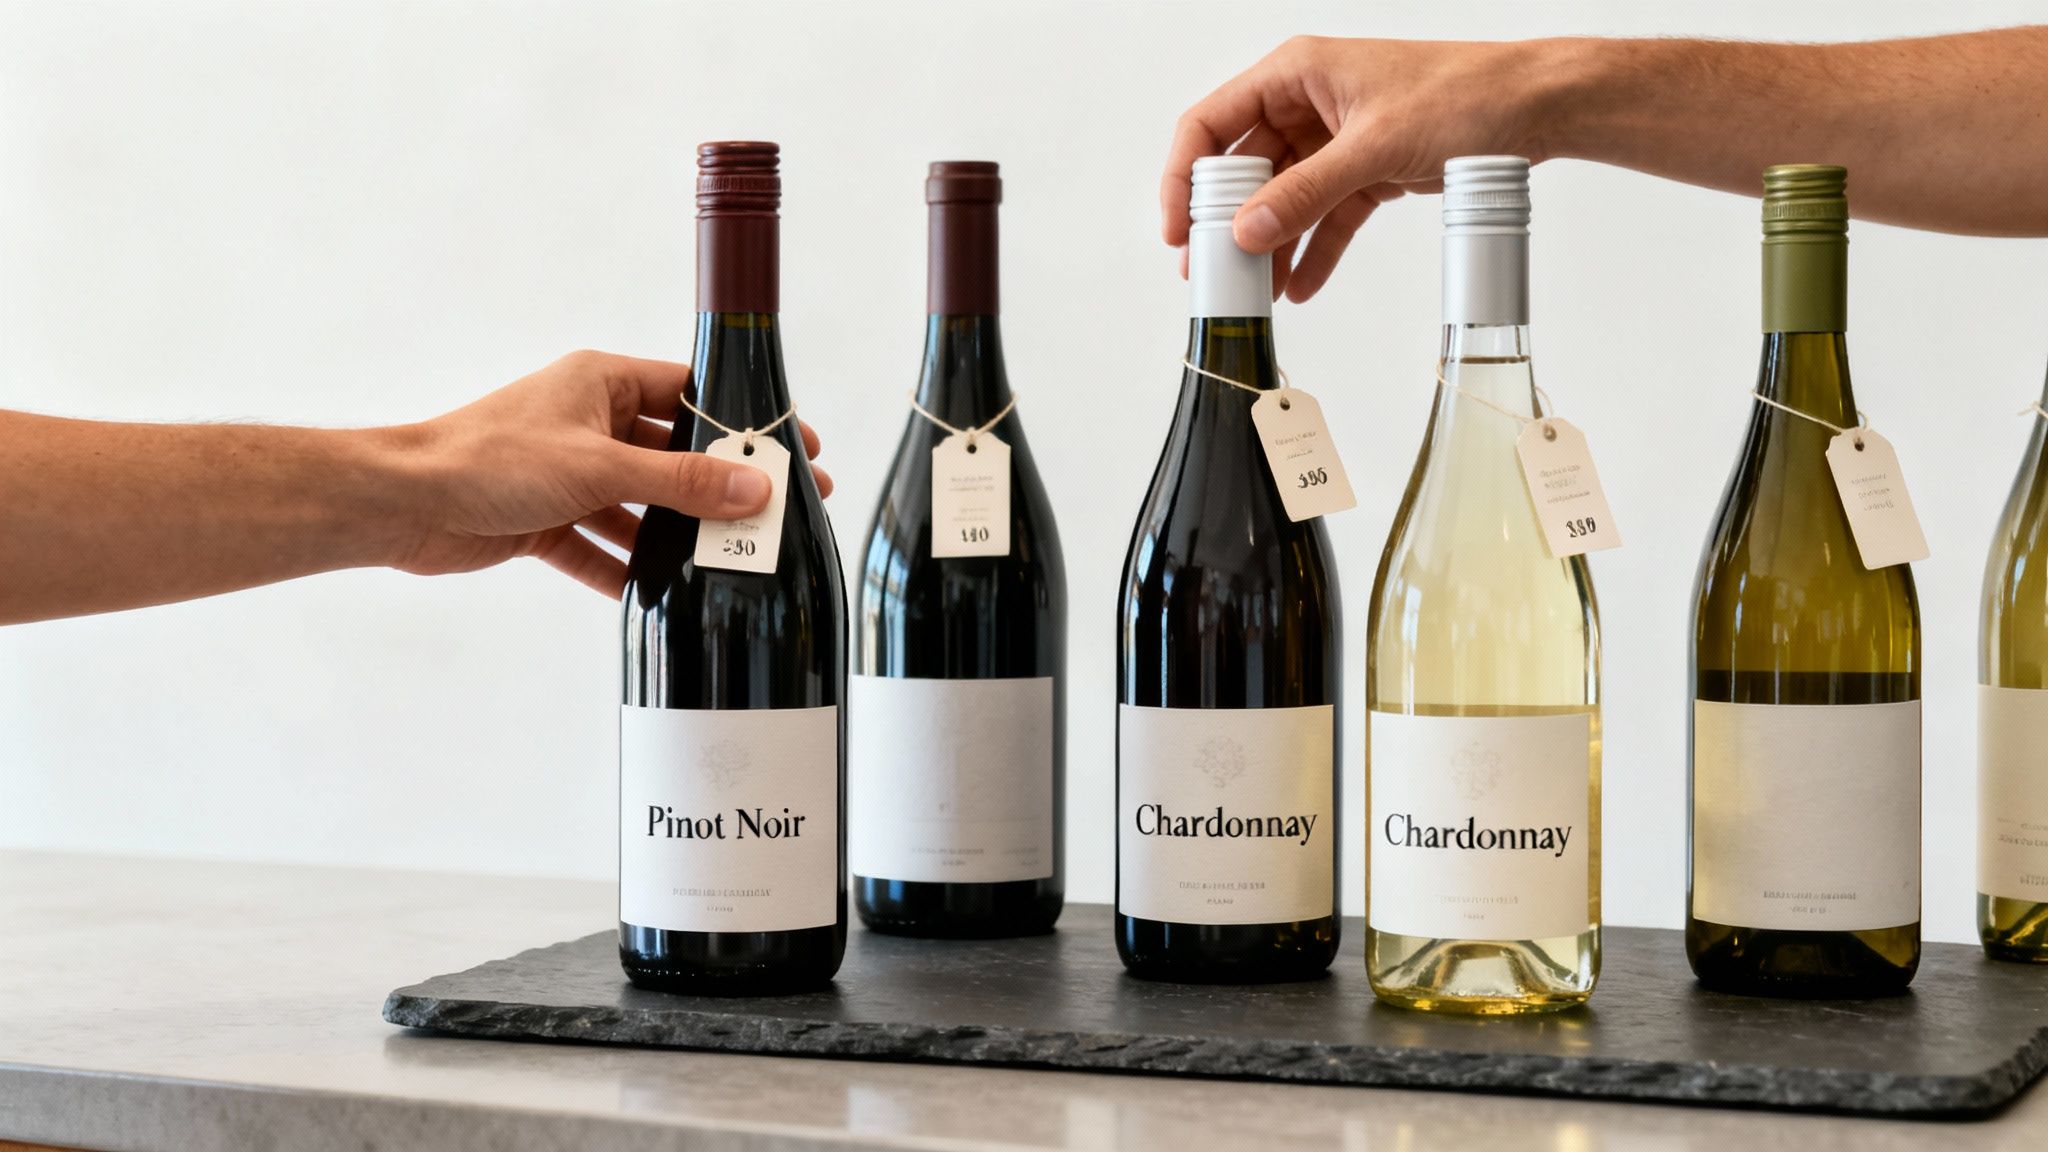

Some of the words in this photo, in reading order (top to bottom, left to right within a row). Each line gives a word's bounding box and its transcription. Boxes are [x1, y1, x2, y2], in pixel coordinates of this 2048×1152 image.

[647, 805, 726, 840] Pinot
[735, 805, 806, 840] Noir
[1135, 803, 1318, 847] Chardonnay
[1385, 814, 1572, 858] Chardonnay
